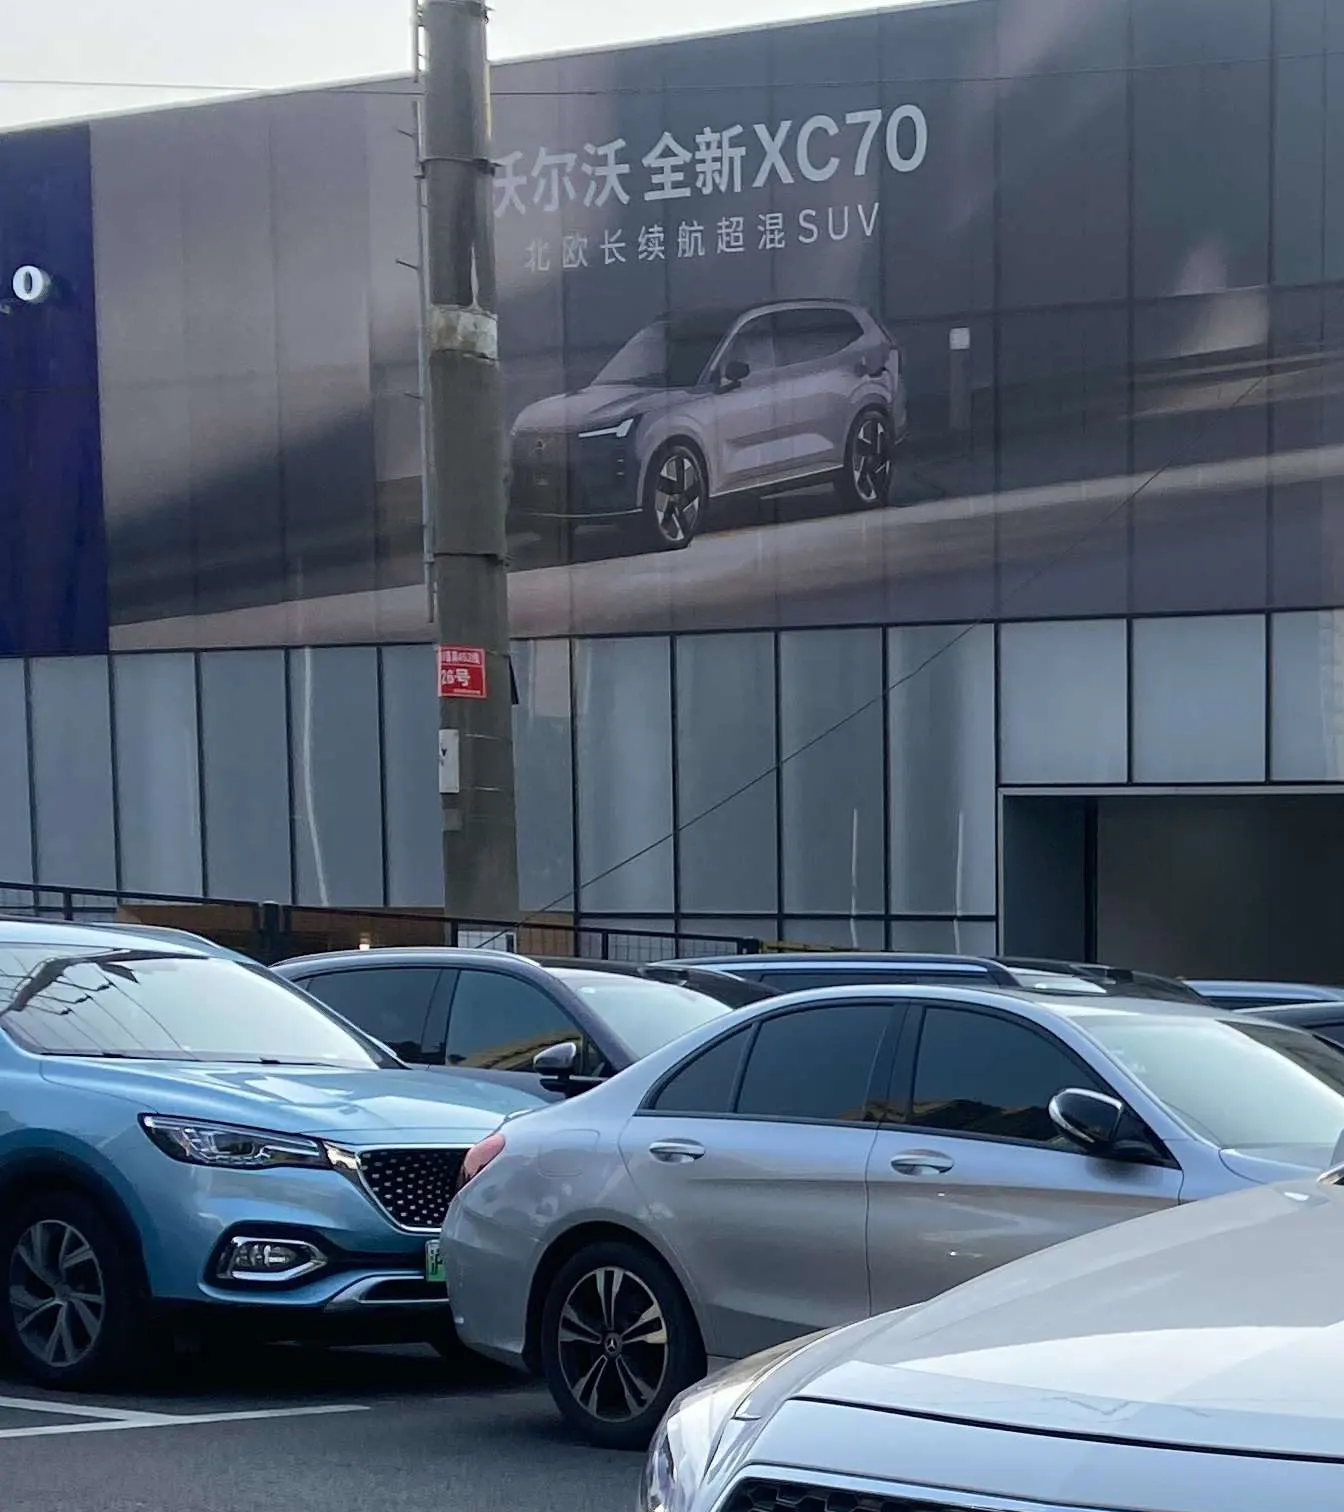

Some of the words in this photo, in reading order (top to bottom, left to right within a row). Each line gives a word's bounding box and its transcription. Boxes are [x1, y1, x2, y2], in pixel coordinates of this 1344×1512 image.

[642, 104, 928, 201] 全新XC70
[524, 202, 880, 273] 北欧长续航超混SUV
